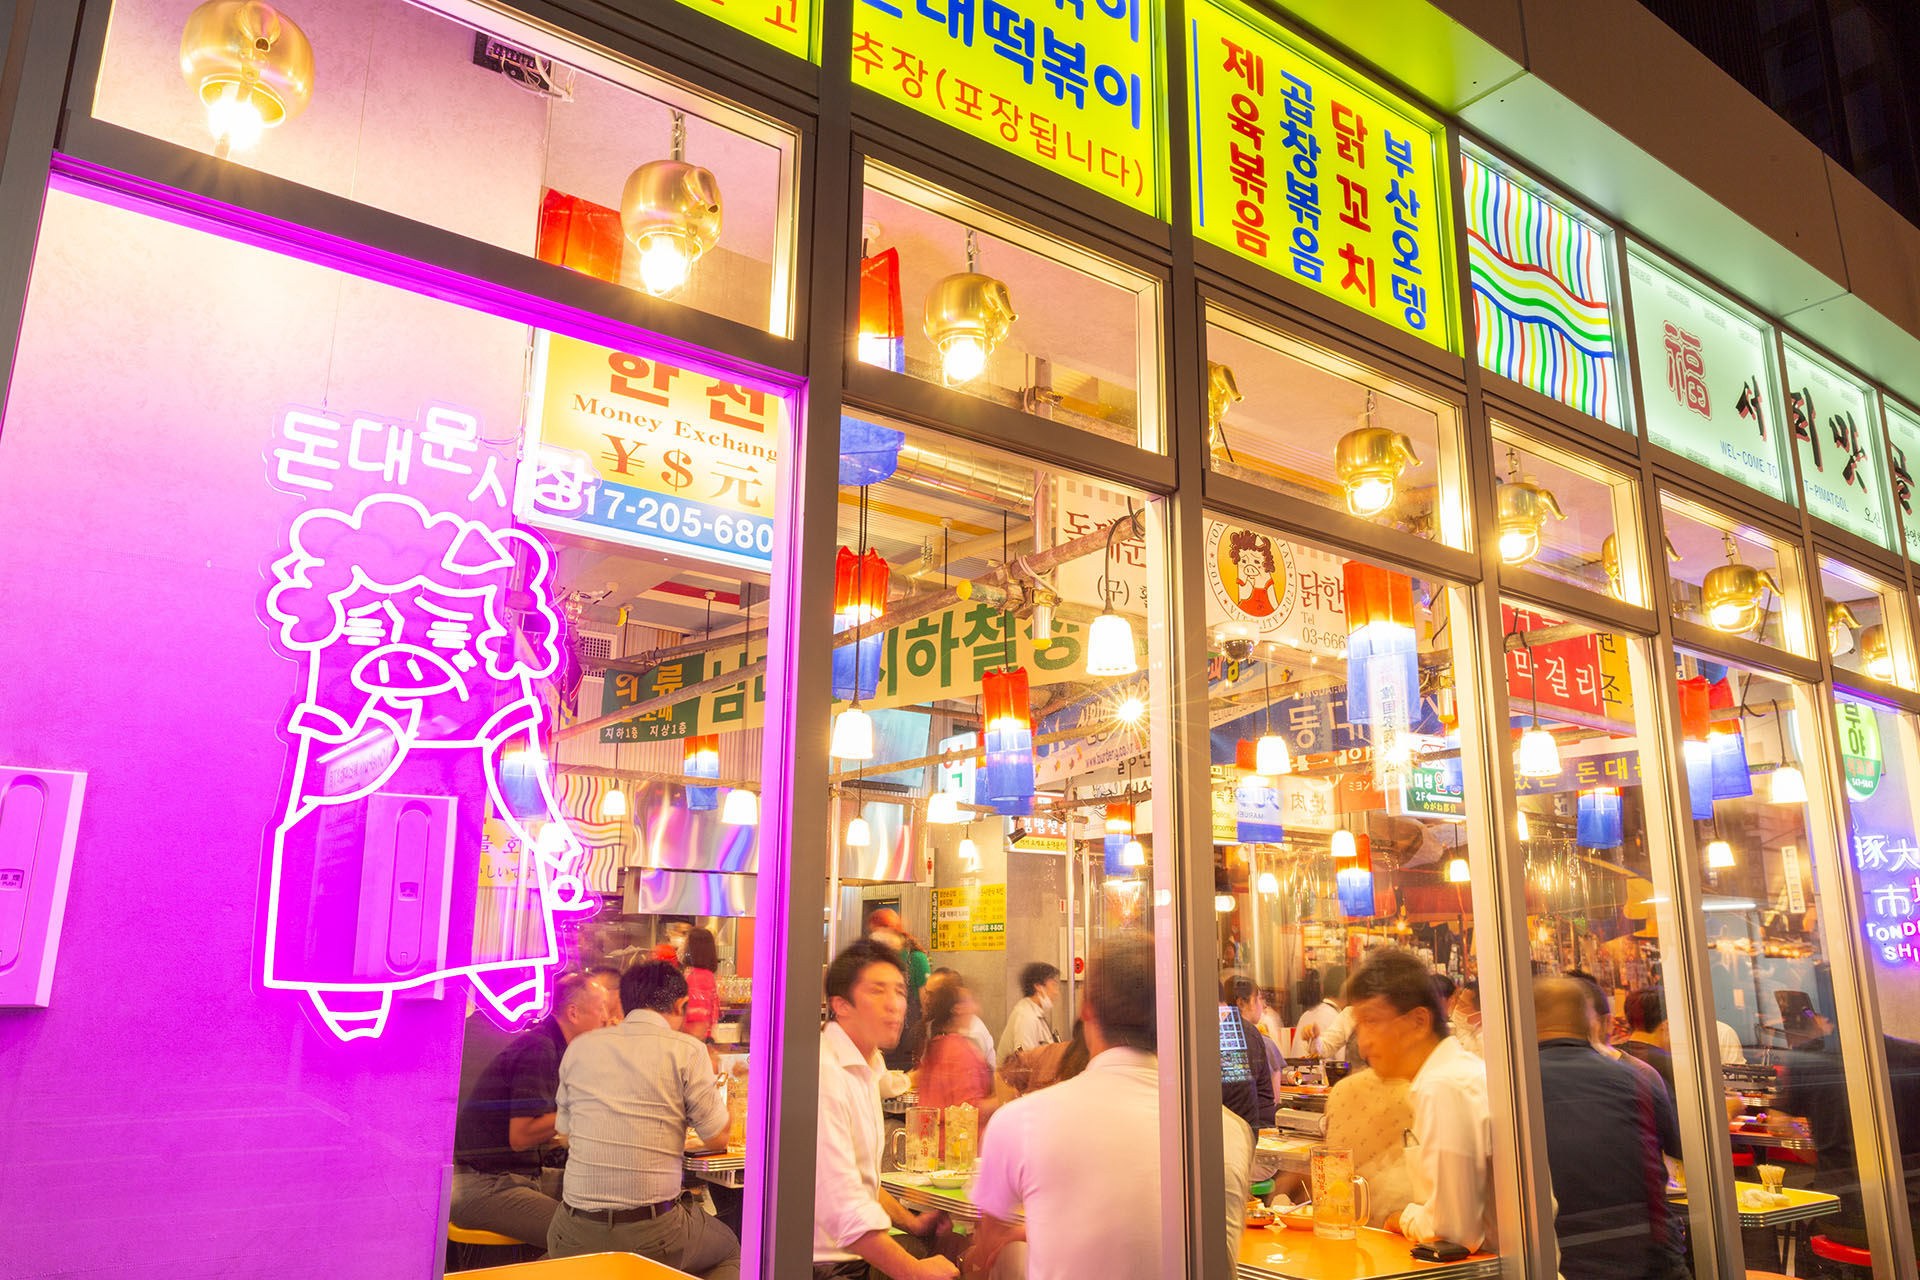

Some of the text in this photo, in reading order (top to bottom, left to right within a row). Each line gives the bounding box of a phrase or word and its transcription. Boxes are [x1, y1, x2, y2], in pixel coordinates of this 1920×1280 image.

[858, 0, 1141, 130] 대떡볶이
[1221, 37, 1270, 258] 제육볶음
[1280, 69, 1324, 283] 곱창볶음
[1331, 99, 1376, 308] 닭꼬치
[1384, 129, 1426, 330] 부산오뎅
[572, 393, 663, 432] Money
[1663, 319, 1712, 421] 福
[1301, 612, 1315, 625] Tel
[1415, 791, 1426, 801] 2F
[1866, 920, 1920, 941] TOND
